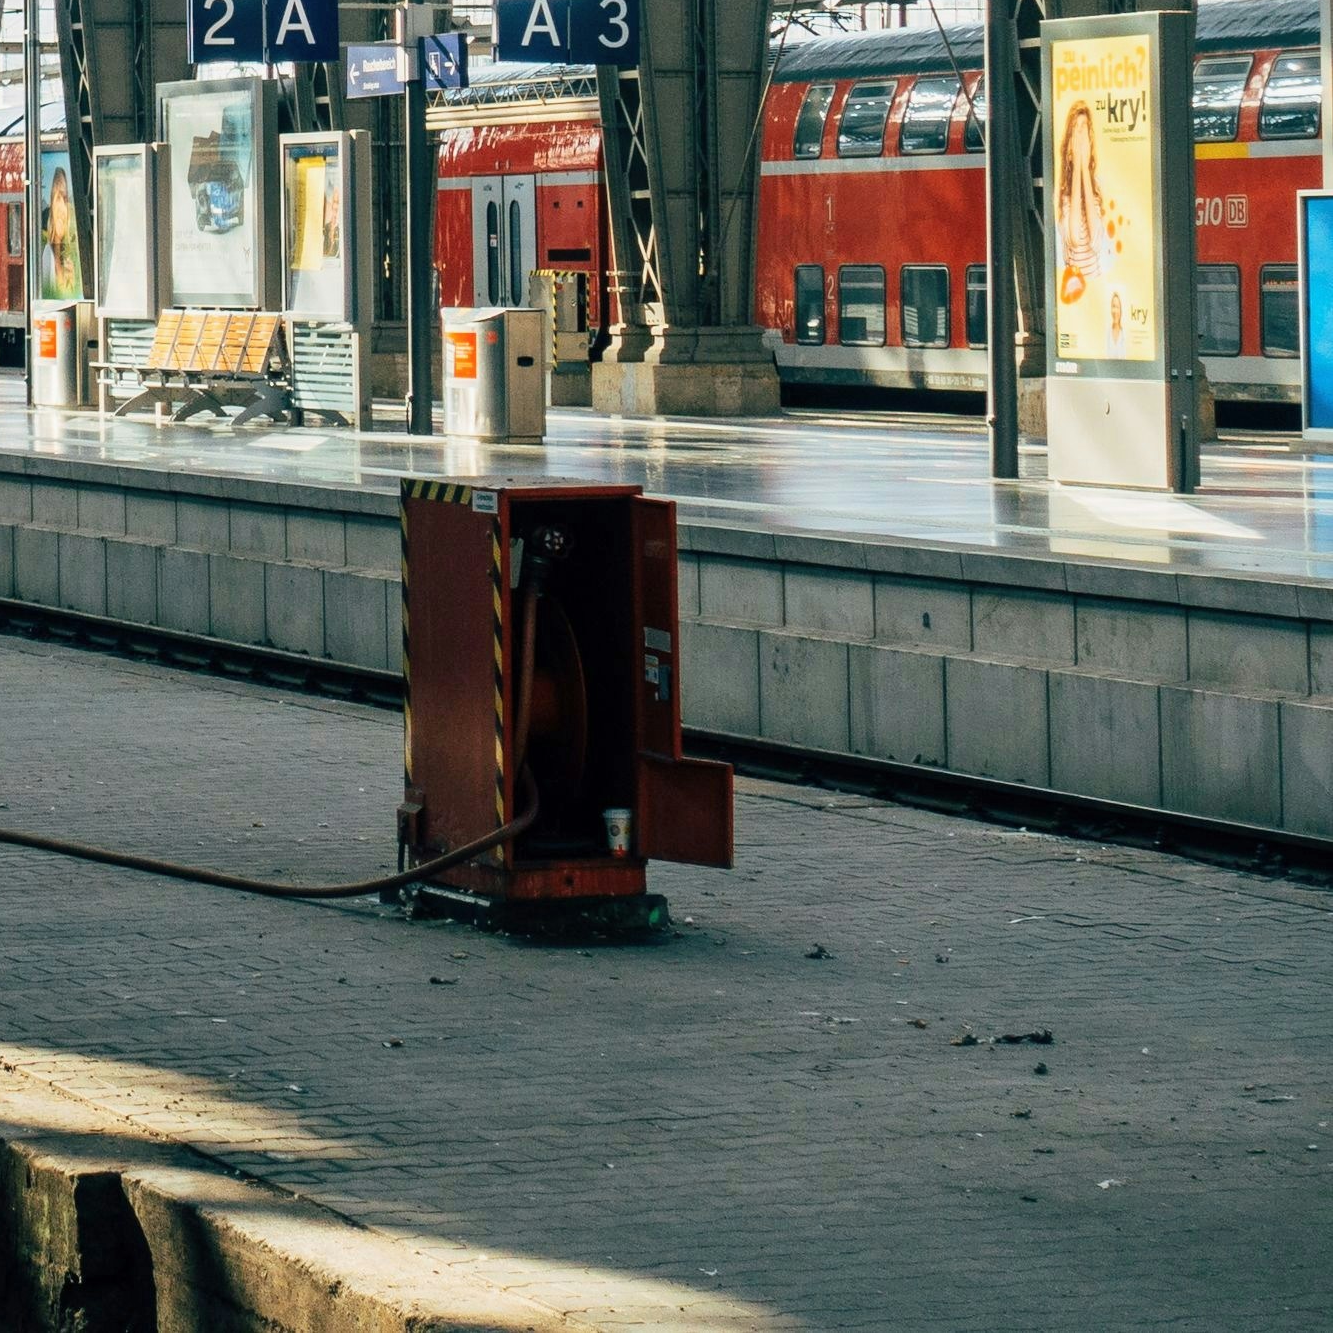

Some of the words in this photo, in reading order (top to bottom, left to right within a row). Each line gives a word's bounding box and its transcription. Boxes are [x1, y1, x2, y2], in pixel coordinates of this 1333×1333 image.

[1056, 46, 1146, 101] peinlich?
[1108, 90, 1146, 132] kry!
[826, 196, 832, 221] 1
[1229, 200, 1245, 222] DB
[827, 275, 834, 299] 2
[1131, 305, 1148, 325] kry
